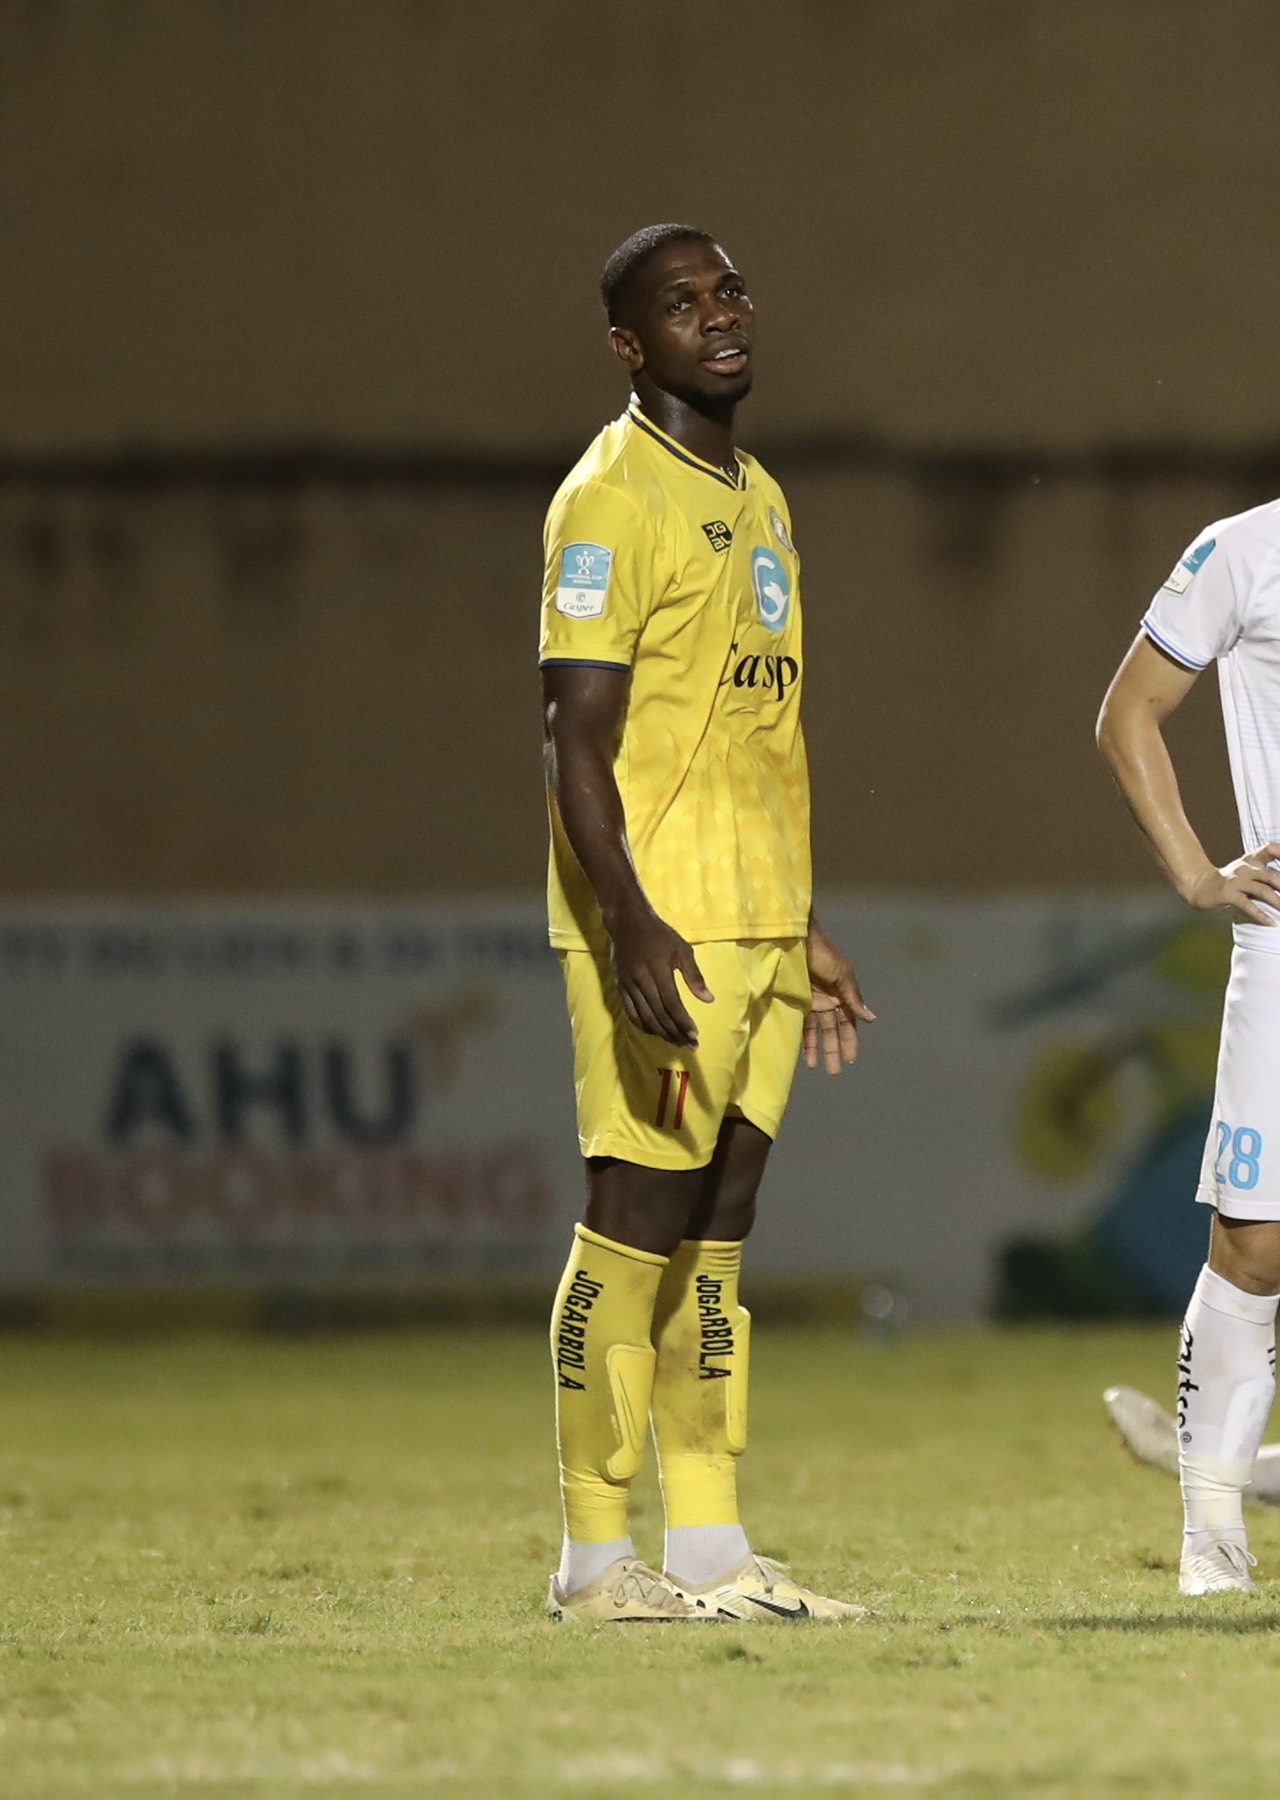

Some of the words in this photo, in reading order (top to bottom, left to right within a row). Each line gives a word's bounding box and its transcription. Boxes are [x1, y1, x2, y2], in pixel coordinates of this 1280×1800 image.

[720, 643, 798, 702] asp
[108, 1035, 417, 1150] AHU
[655, 1067, 689, 1130] 11
[42, 1146, 553, 1228] BOOKING
[1215, 1121, 1263, 1190] 28
[558, 1270, 604, 1391] JOGARBOLA
[695, 1274, 735, 1380] JOGARBOLA
